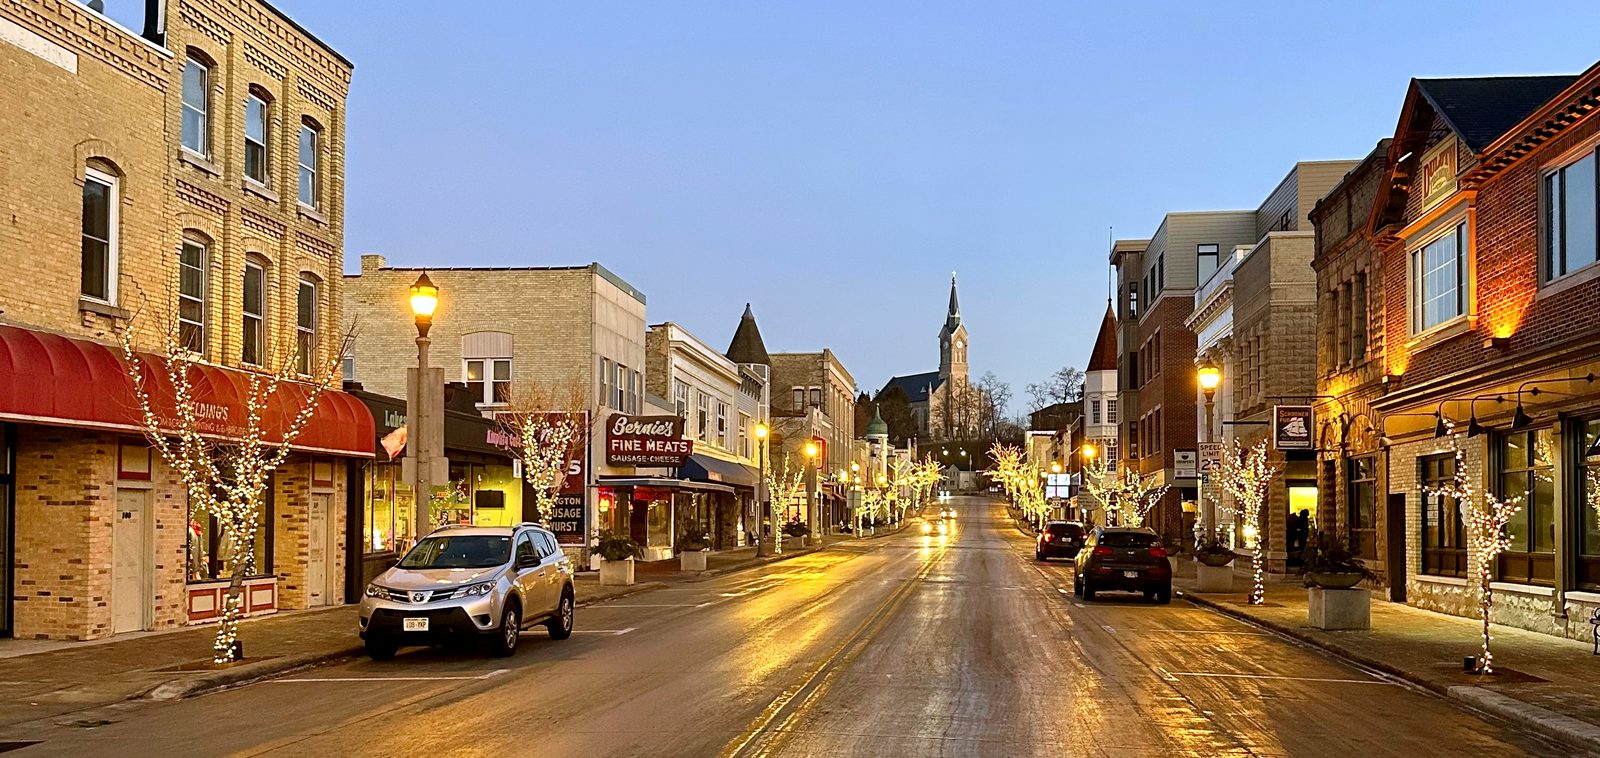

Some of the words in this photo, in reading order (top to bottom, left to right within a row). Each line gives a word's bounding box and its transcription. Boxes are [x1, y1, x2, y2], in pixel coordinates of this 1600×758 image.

[612, 416, 674, 437] Bernie's
[611, 439, 642, 451] FINE
[646, 440, 688, 453] MEATS
[1201, 459, 1222, 471] 25
[552, 508, 581, 519] USAGE
